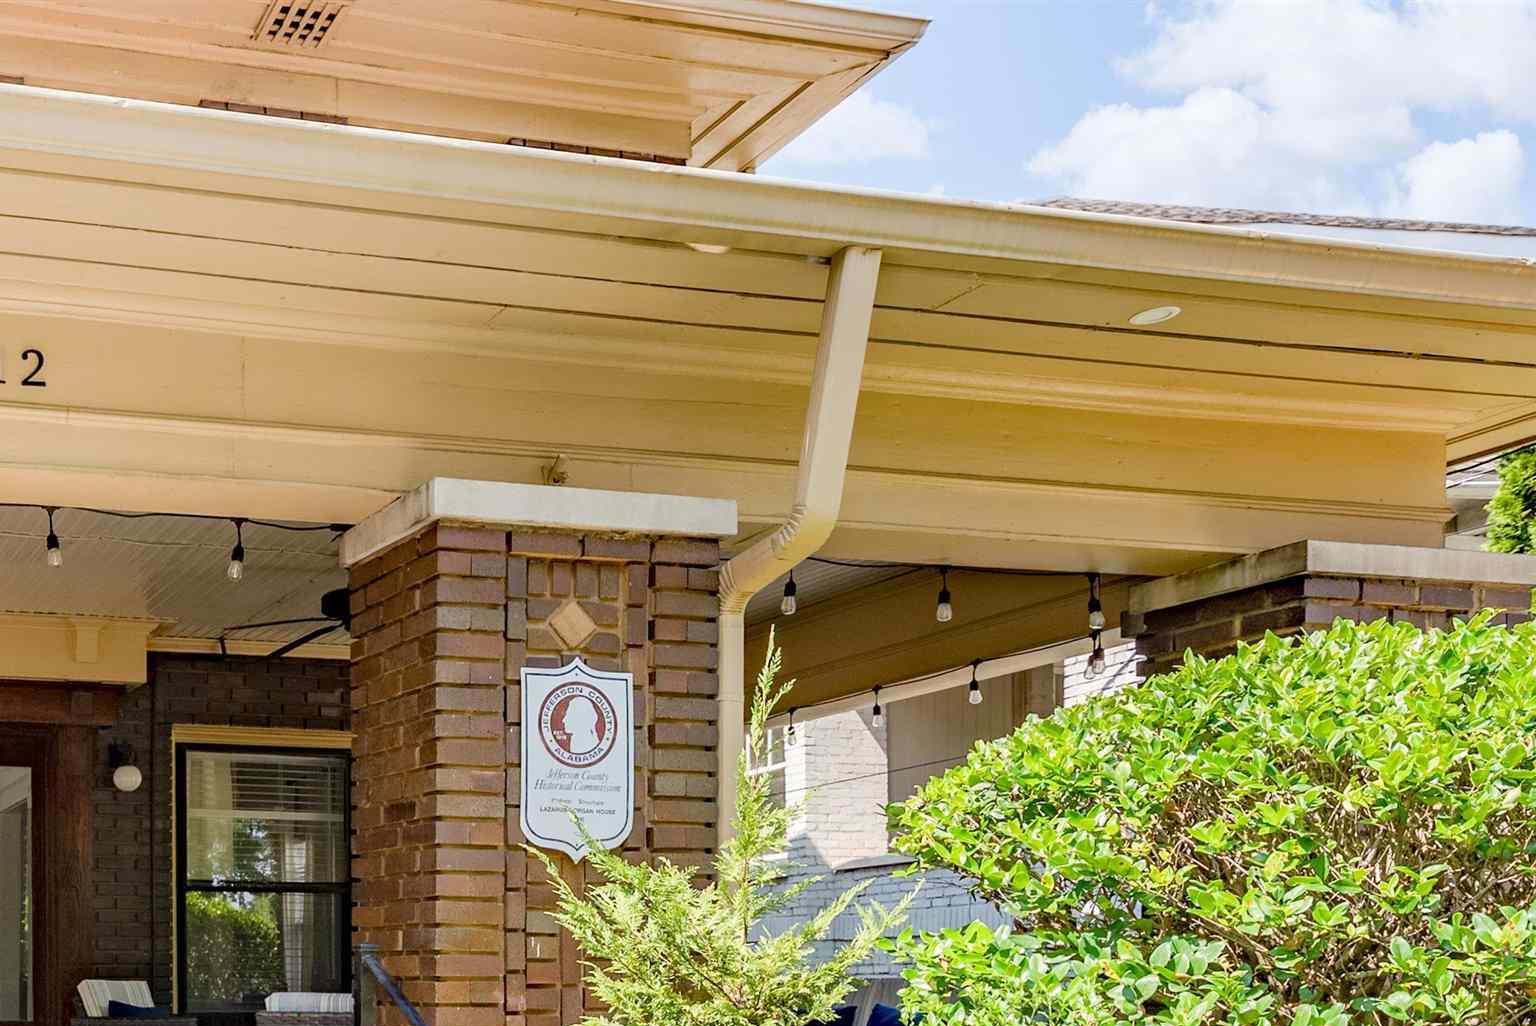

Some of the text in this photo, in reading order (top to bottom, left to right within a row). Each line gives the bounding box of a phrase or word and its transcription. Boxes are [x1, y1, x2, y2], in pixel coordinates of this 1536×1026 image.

[543, 686, 613, 735] JEFFERSON COUNTY
[554, 746, 604, 763] ALABAMA
[547, 768, 608, 783] Jefferson County
